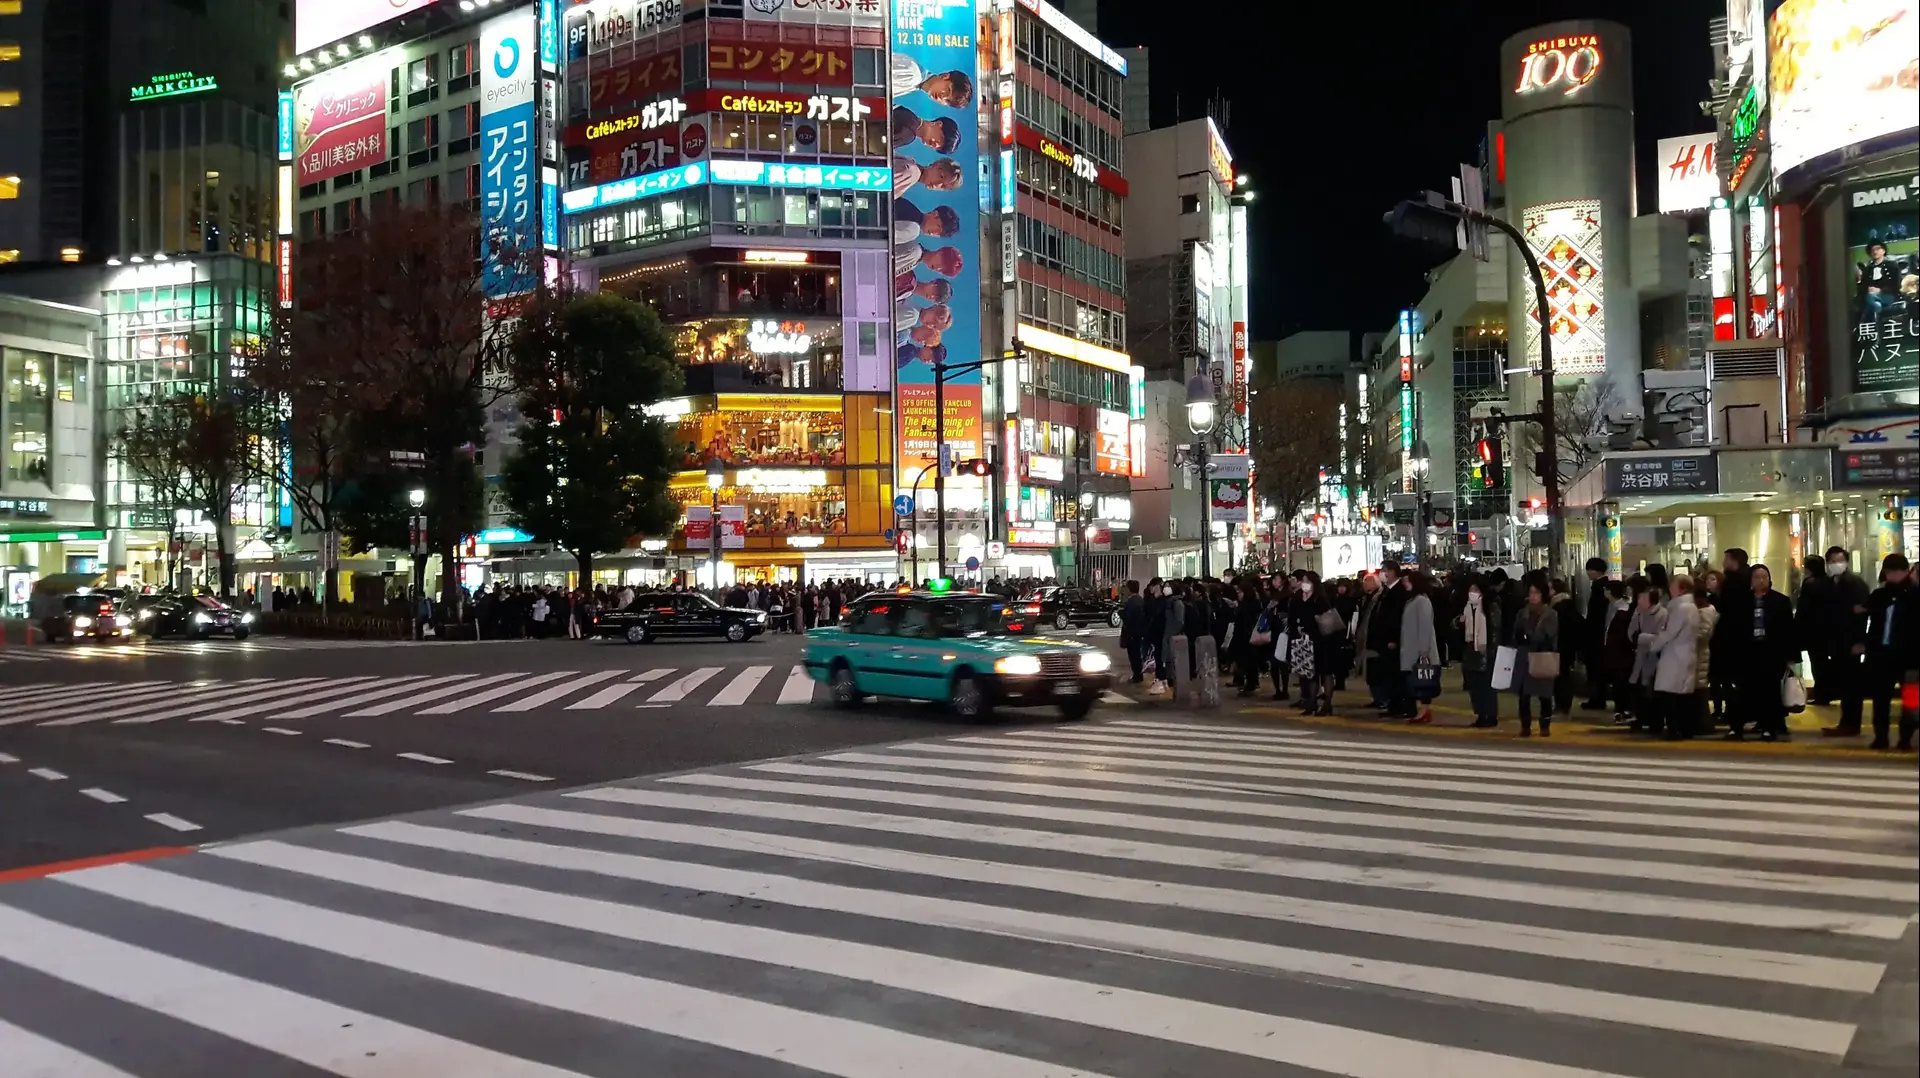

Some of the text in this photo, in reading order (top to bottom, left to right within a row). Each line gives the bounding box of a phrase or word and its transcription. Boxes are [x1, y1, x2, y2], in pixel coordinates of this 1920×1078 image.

[570, 25, 587, 45] 9F
[897, 32, 970, 48] 12.13 ON SALE
[1529, 36, 1598, 53] SHIBUYA
[709, 45, 848, 76] コンタクト
[1514, 46, 1600, 96] 109
[131, 76, 215, 97] MARK CITY
[151, 71, 193, 83] SHIBUYA
[487, 78, 528, 102] eyecity
[335, 92, 377, 118] クリニック
[641, 97, 687, 130] ガスト
[806, 94, 871, 122] ガスト
[309, 133, 381, 174] 品川美容外科
[620, 138, 675, 177] ガスト
[570, 159, 590, 181] 7F
[1072, 153, 1099, 183] ガスト
[1853, 185, 1907, 208] DMM
[904, 416, 975, 427] The Begning of
[1621, 472, 1669, 488] 渋谷駅
[17, 500, 48, 512] 渋谷駅
[1417, 668, 1434, 680] GAP
